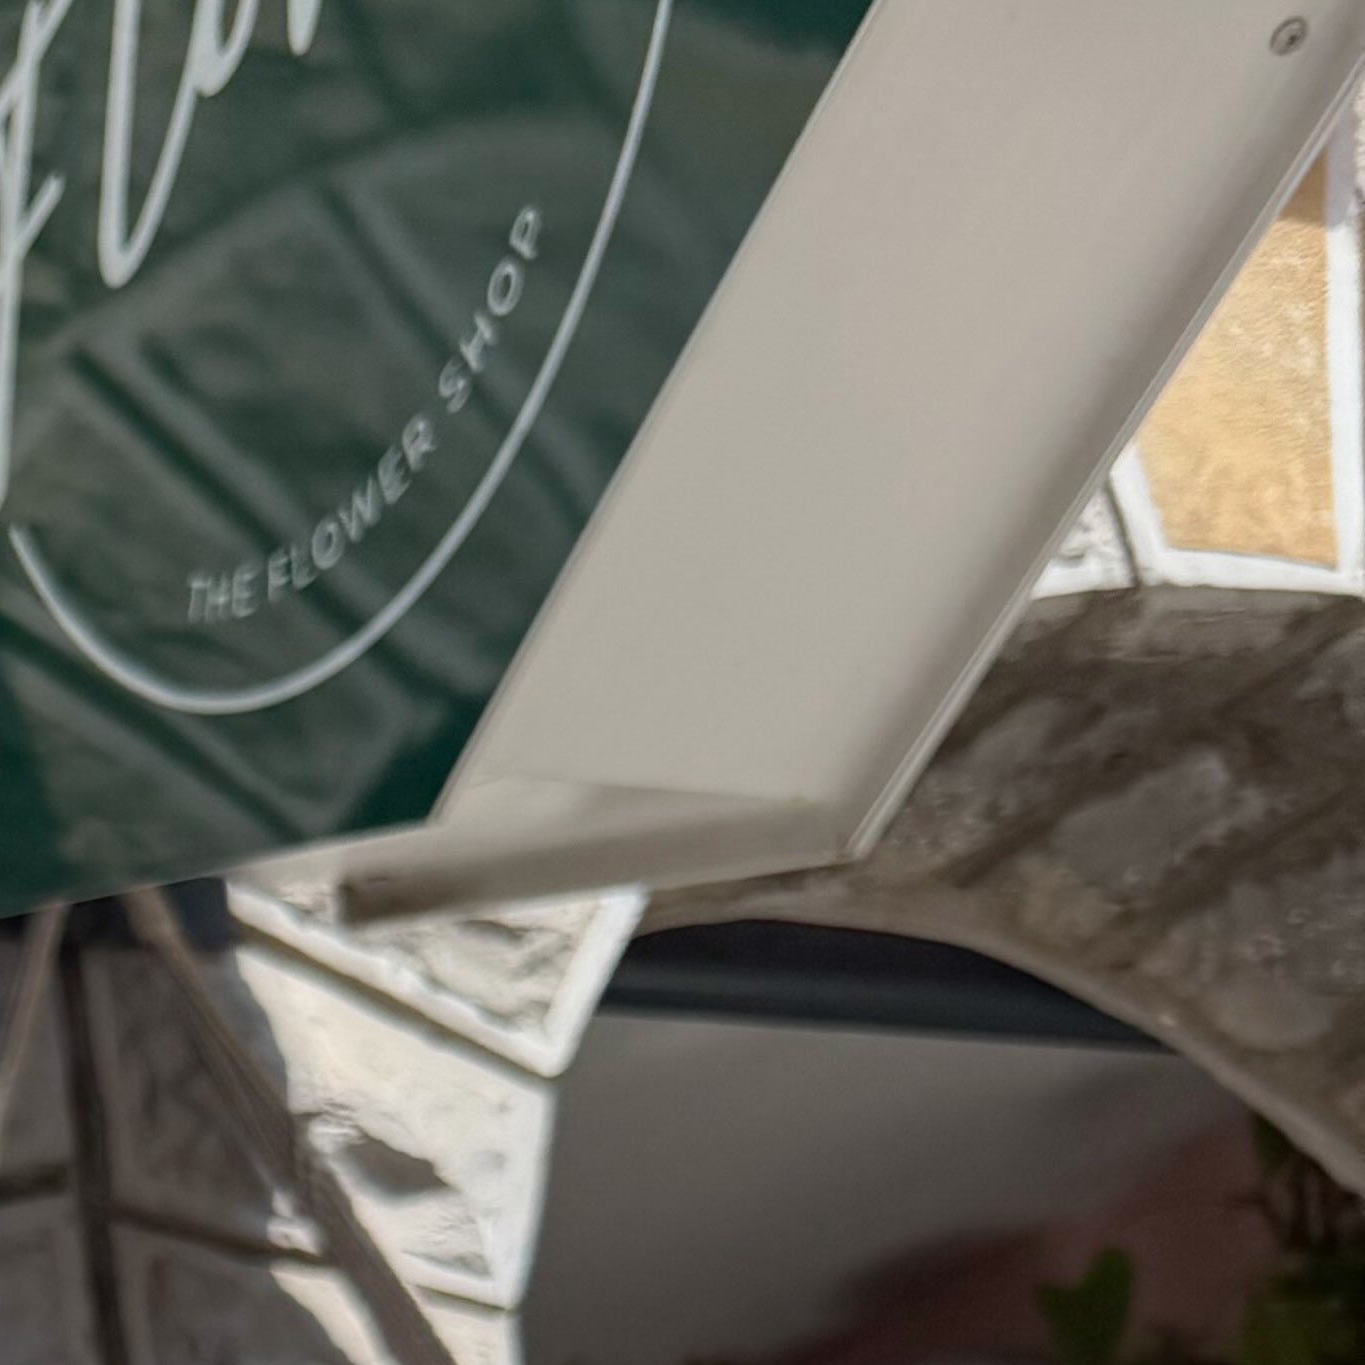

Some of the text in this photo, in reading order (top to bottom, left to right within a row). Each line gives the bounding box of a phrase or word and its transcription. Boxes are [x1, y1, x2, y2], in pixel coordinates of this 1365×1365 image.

[187, 205, 543, 624] THE FLOWER SHOP
